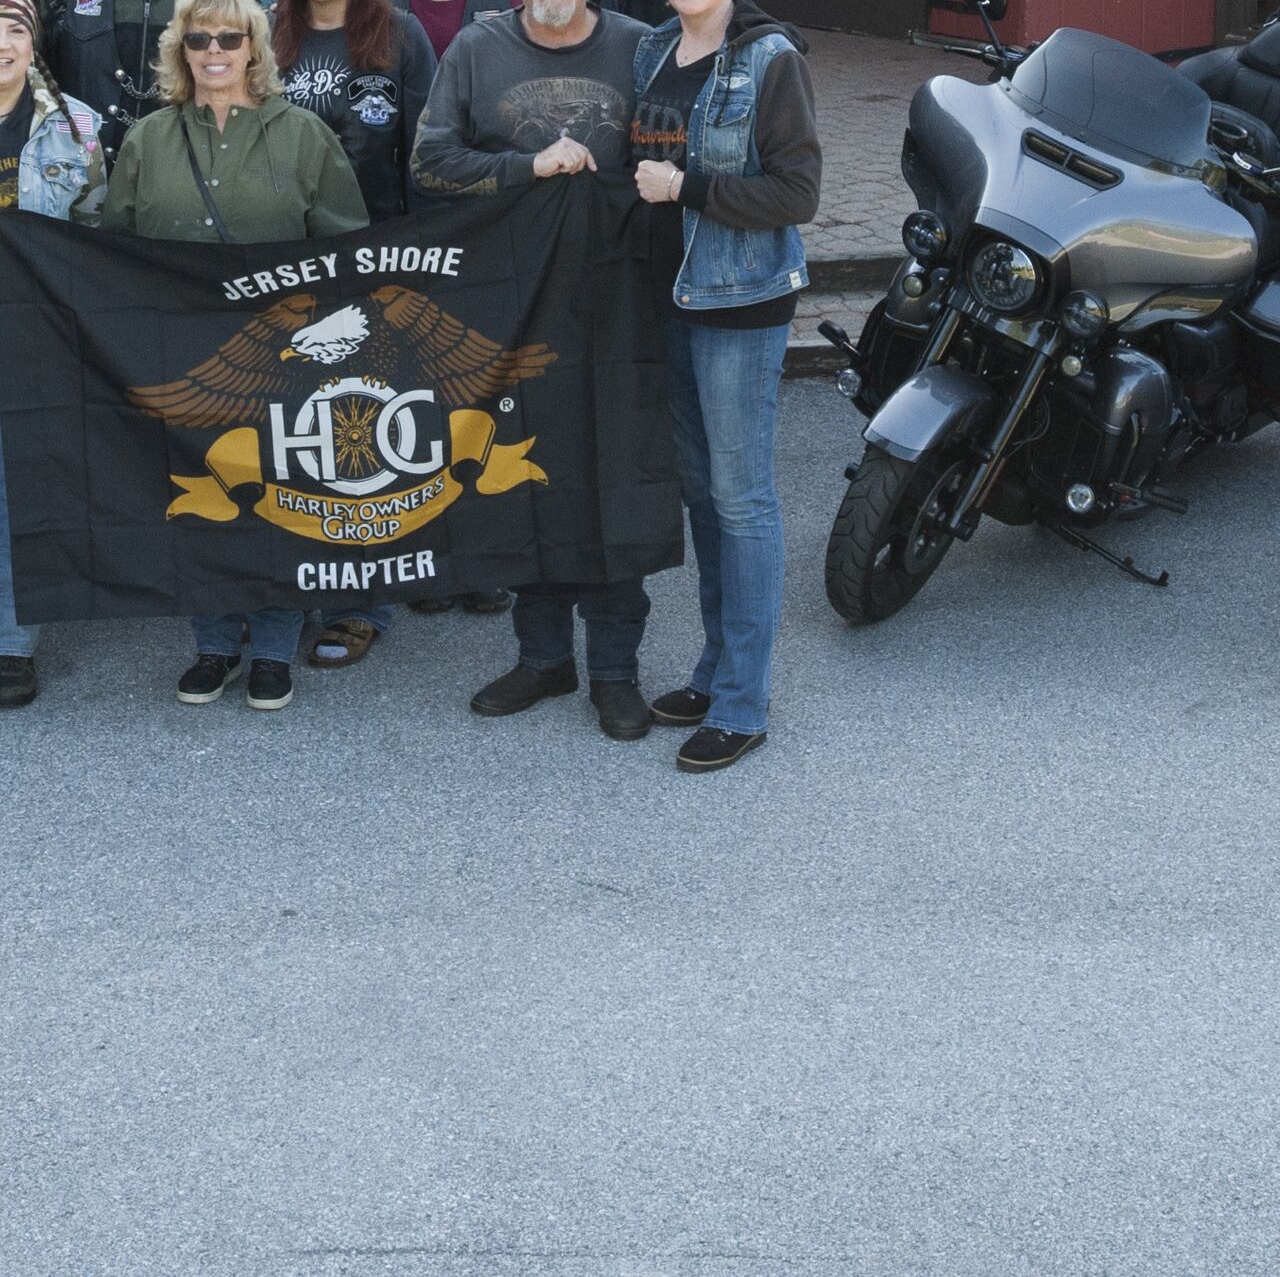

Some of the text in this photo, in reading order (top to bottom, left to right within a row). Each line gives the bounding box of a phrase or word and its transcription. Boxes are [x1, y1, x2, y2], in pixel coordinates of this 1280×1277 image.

[222, 247, 463, 300] JERSEY SHORE
[277, 475, 445, 521] HARLEY OWNERS
[322, 515, 400, 541] GROUP
[297, 550, 436, 590] CHAPTER
